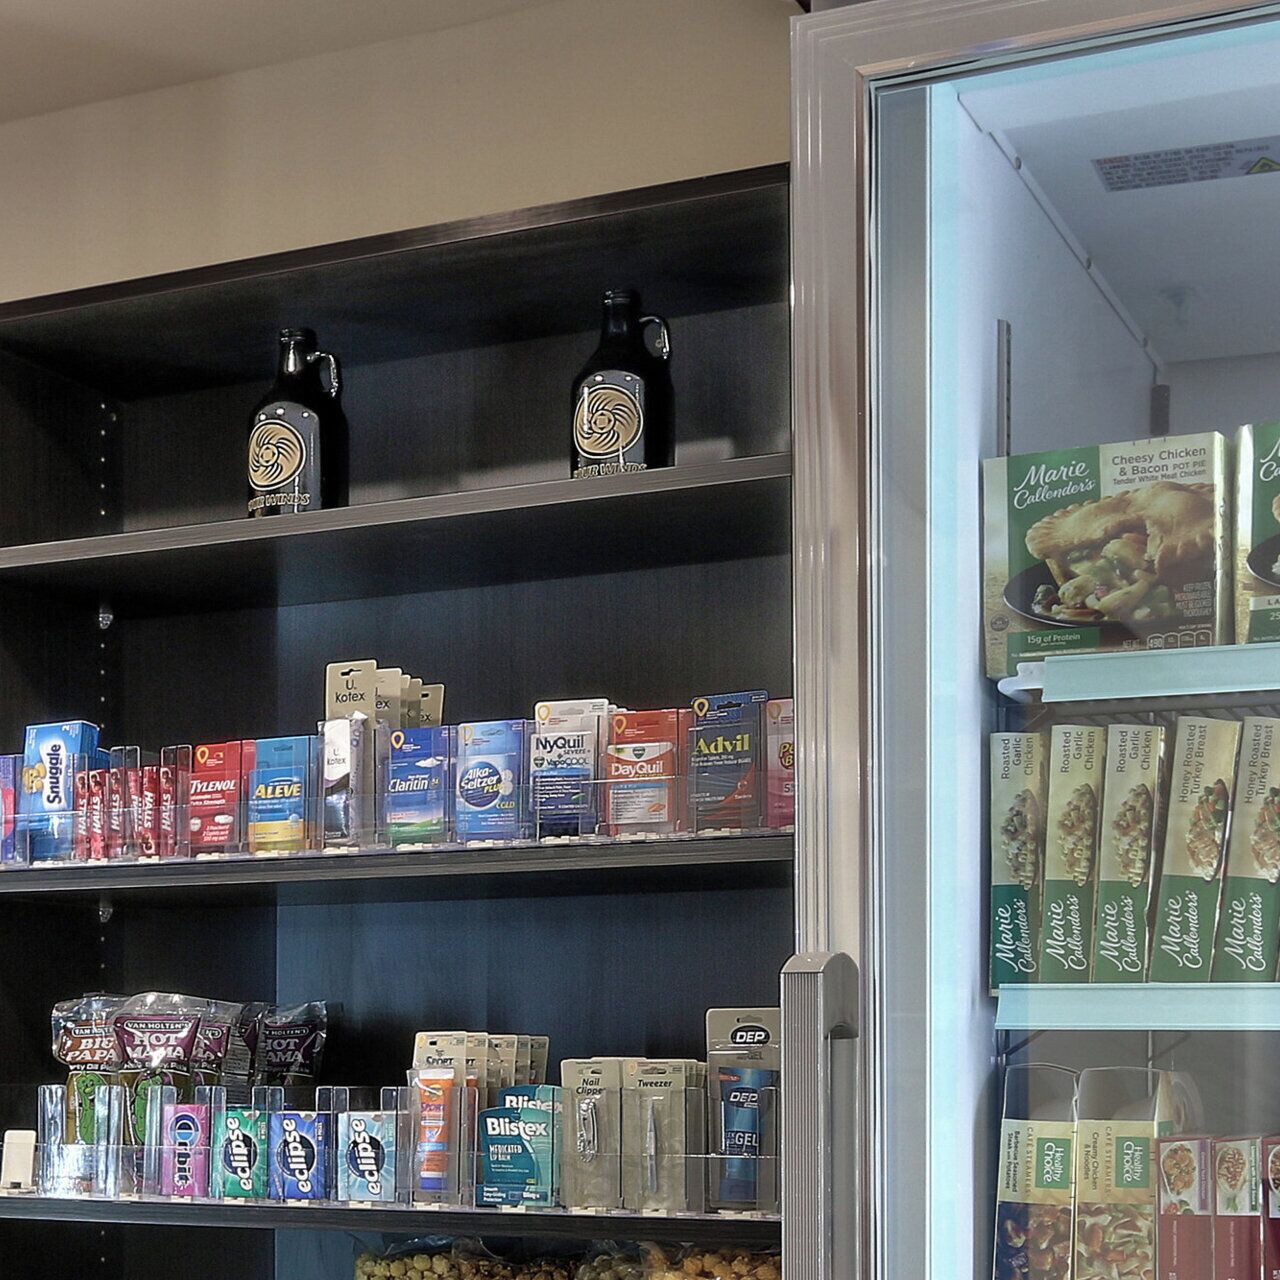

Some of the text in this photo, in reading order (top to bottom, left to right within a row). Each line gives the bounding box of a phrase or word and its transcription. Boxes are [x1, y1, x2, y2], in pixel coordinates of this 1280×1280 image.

[1112, 447, 1206, 466] Cheesy Chicken
[1014, 460, 1089, 492] Marie
[1132, 464, 1169, 475] Bacon
[1014, 479, 1096, 509] Callender's
[335, 691, 365, 704] kotex
[536, 735, 584, 754] NyQuil
[695, 734, 750, 754] Advil
[1061, 731, 1071, 773] Roasted
[1073, 731, 1083, 759] Garlic
[1085, 731, 1094, 770] Chicken
[1184, 724, 1197, 768] Roasted
[1196, 724, 1208, 759] Breast
[47, 744, 62, 804] Snuggle
[466, 768, 493, 779] Alka-
[612, 761, 663, 777] DayQuil
[190, 780, 236, 794] TYLENOL
[254, 784, 301, 798] ALEVE
[389, 777, 428, 793] Claritin
[461, 775, 500, 790] Seltzer
[92, 797, 103, 833] HALLS
[735, 1031, 766, 1043] DEP
[582, 1078, 600, 1086] Nail
[730, 1092, 758, 1102] DEP
[486, 1117, 548, 1141] Blistex
[735, 1132, 758, 1146] GEL
[227, 1117, 252, 1191] eclipse
[283, 1118, 312, 1193] eclipse
[352, 1118, 382, 1195] eclipse
[489, 1145, 522, 1153] MEDICATED
[1042, 1143, 1054, 1185] Choice
[1053, 1147, 1065, 1181] Healthy
[1123, 1141, 1134, 1184] Choice
[1132, 1146, 1144, 1181] Healthy
